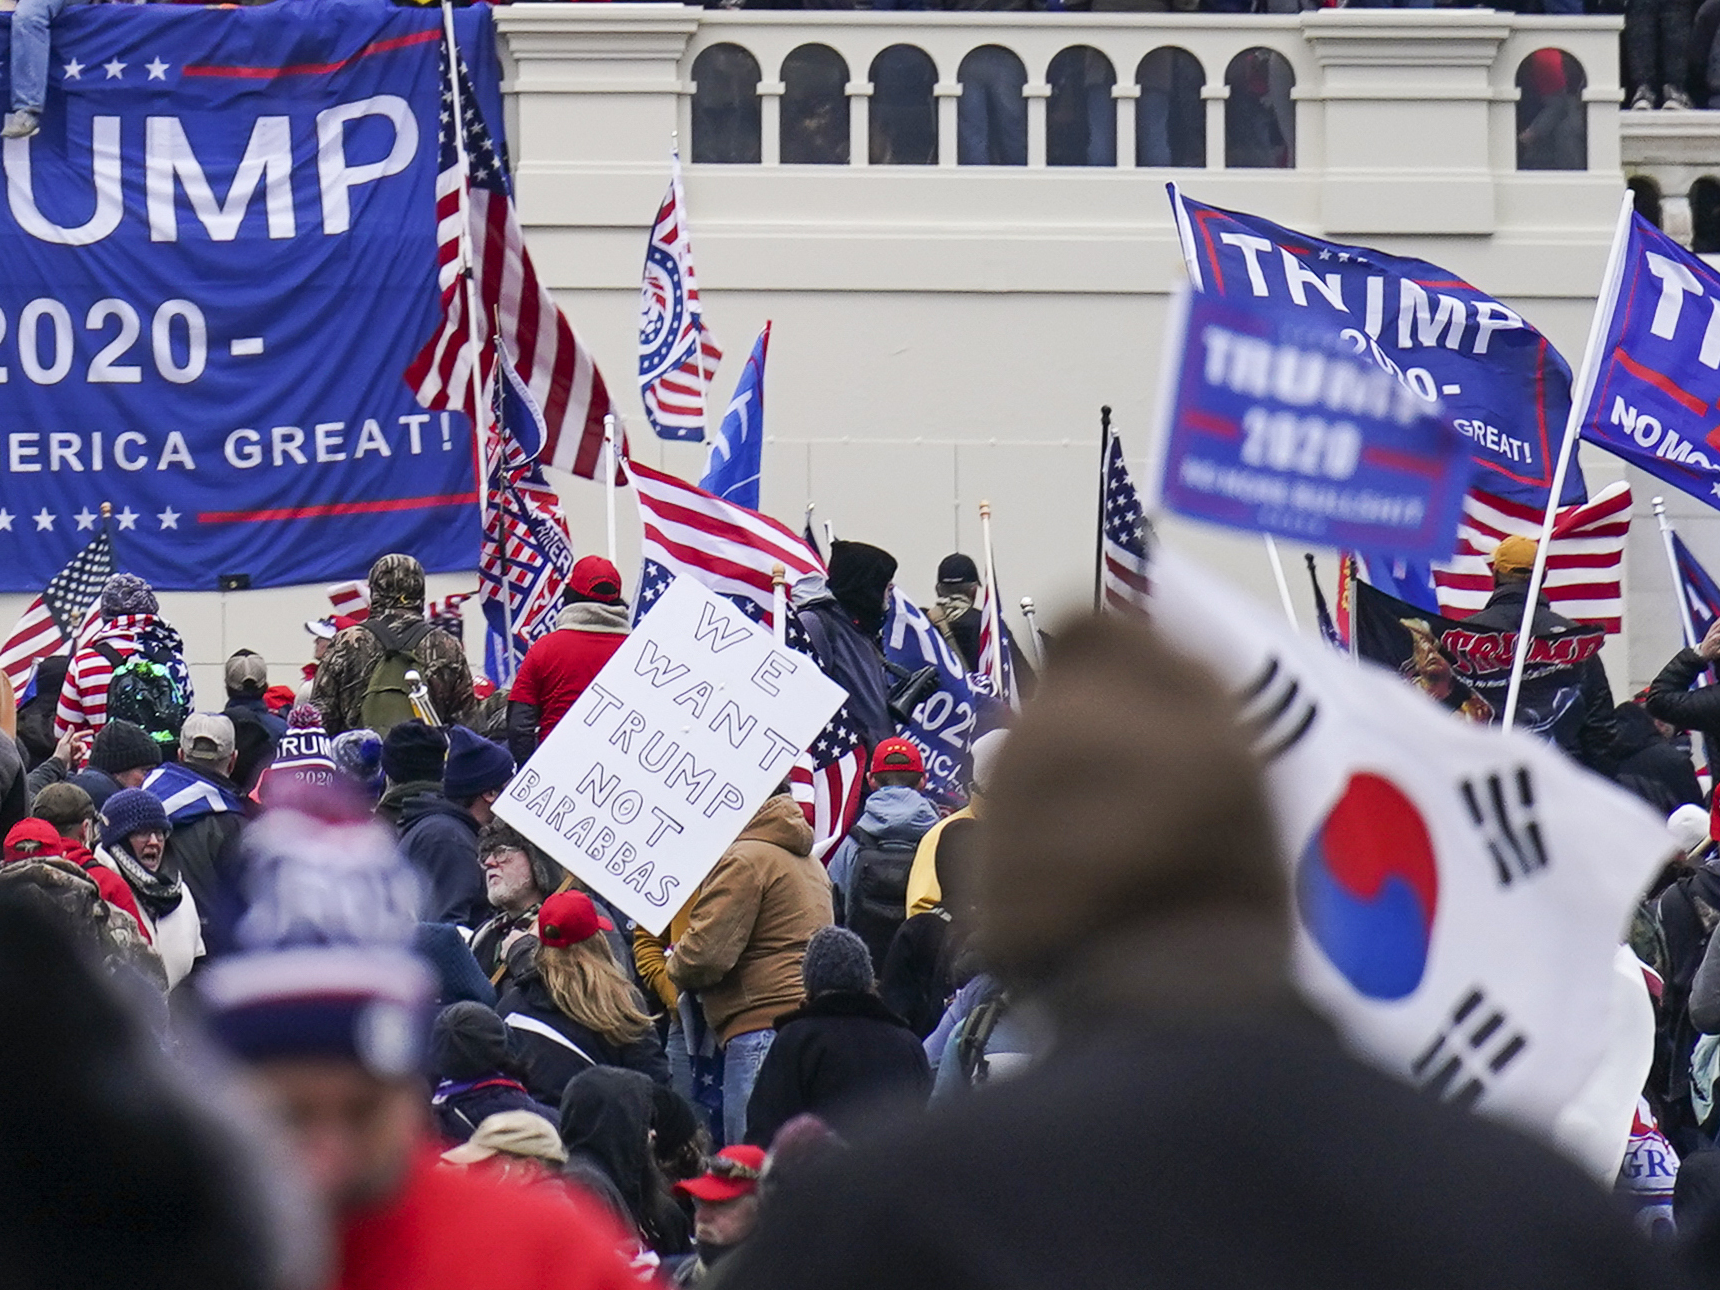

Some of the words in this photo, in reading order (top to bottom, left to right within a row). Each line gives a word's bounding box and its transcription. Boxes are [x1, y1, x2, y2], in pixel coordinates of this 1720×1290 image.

[224, 412, 454, 469] GREAT!
[1241, 408, 1362, 481] 2020
[1453, 419, 1532, 464] GREAT!
[695, 601, 798, 697] WE
[583, 682, 745, 818] TRUMP
[634, 639, 800, 771] WANT
[510, 769, 680, 907] BARABBAS
[576, 762, 684, 848] NOT
